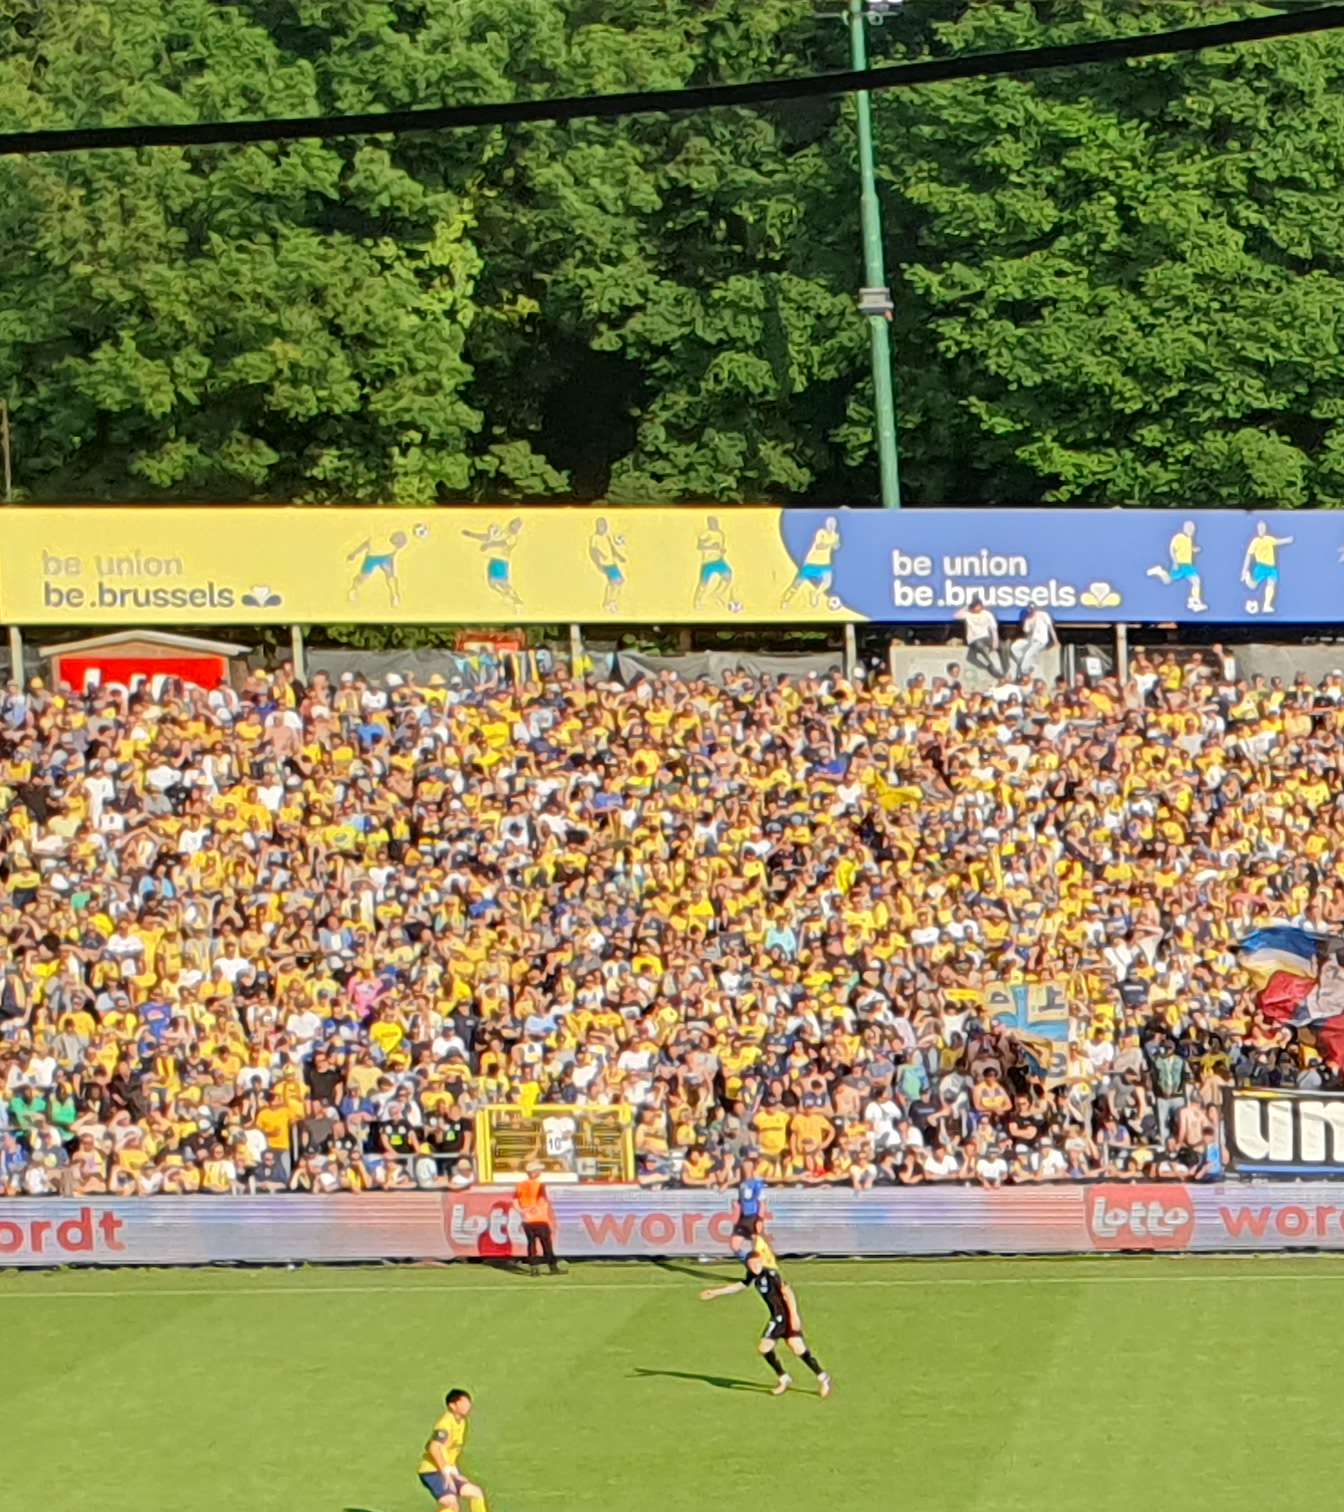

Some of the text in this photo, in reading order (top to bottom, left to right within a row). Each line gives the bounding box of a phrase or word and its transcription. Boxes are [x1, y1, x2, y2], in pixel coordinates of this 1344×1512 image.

[42, 549, 183, 577] be union
[893, 548, 1027, 577] be union
